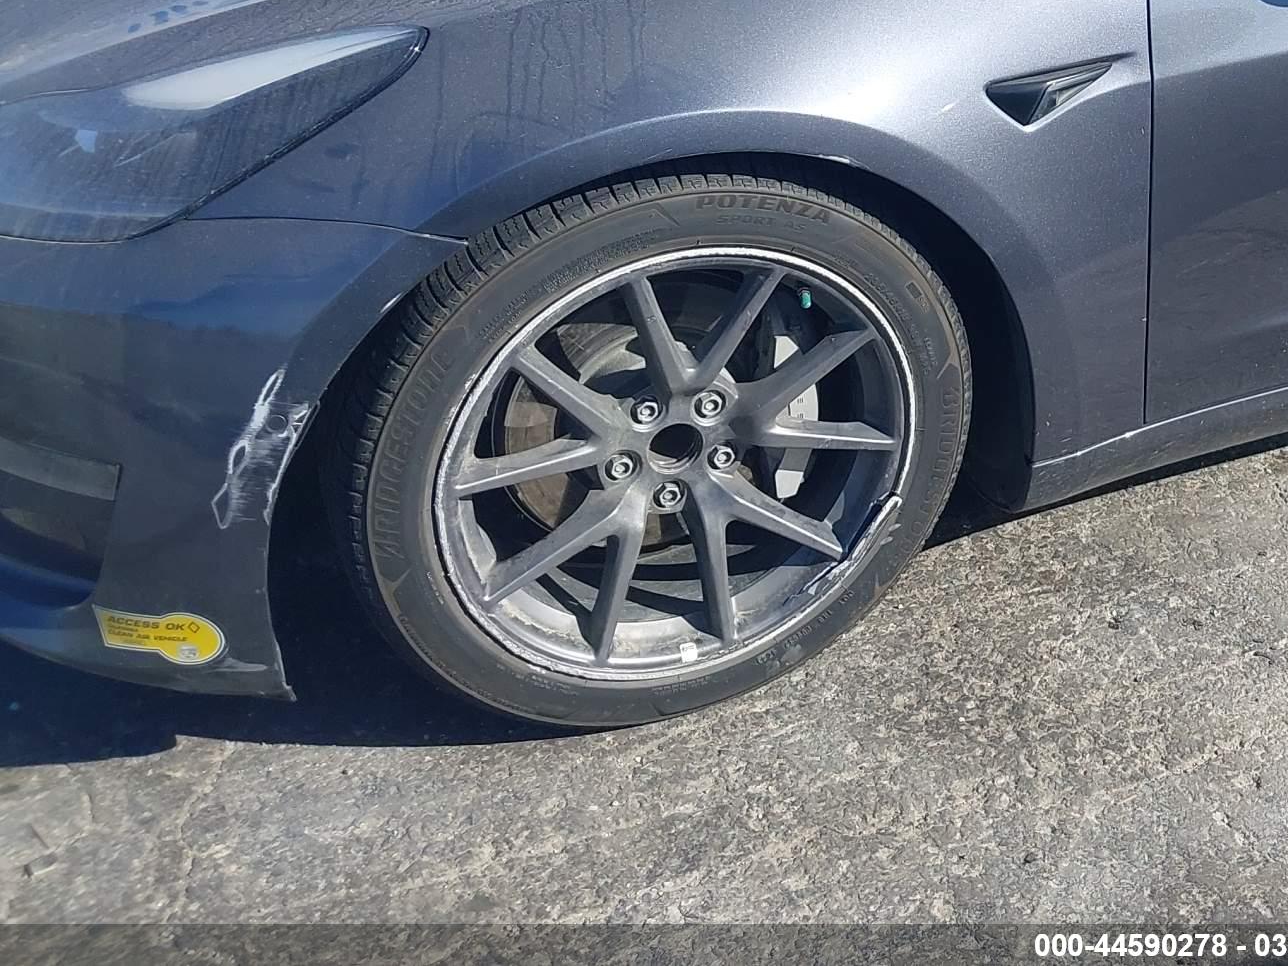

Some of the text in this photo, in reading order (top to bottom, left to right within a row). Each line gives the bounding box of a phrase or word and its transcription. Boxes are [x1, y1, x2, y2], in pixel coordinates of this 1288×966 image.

[695, 194, 831, 226] POTENZA
[715, 214, 776, 226] SPORT
[107, 615, 160, 630] ACCESS
[165, 621, 185, 632] OK
[153, 634, 188, 642] VEHICLE
